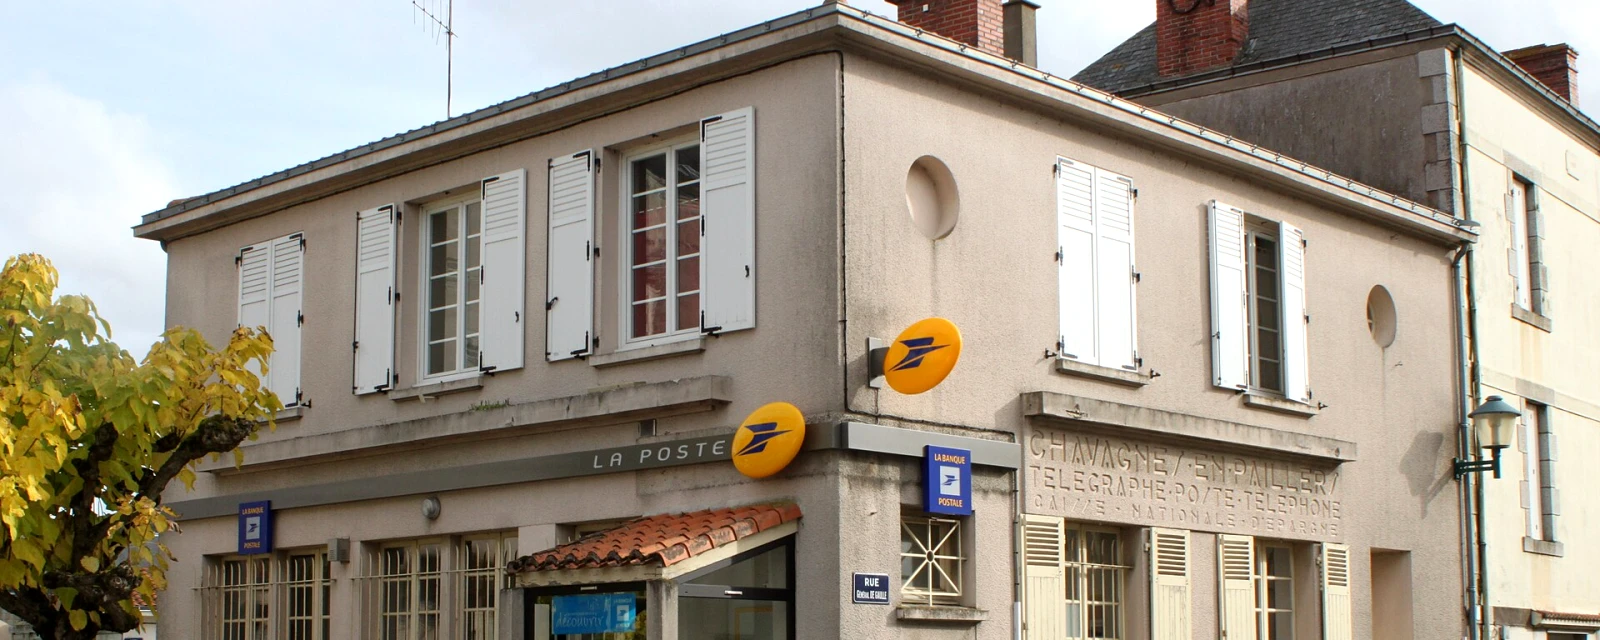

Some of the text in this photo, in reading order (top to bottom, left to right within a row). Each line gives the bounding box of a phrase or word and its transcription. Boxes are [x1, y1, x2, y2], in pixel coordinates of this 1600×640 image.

[593, 440, 726, 469] LA POSTE
[934, 453, 966, 464] LA BANQUE
[938, 497, 963, 508] POSTALE
[1132, 503, 1236, 527] NATIONALE
[864, 577, 880, 587] RUE
[870, 590, 875, 599] DE
